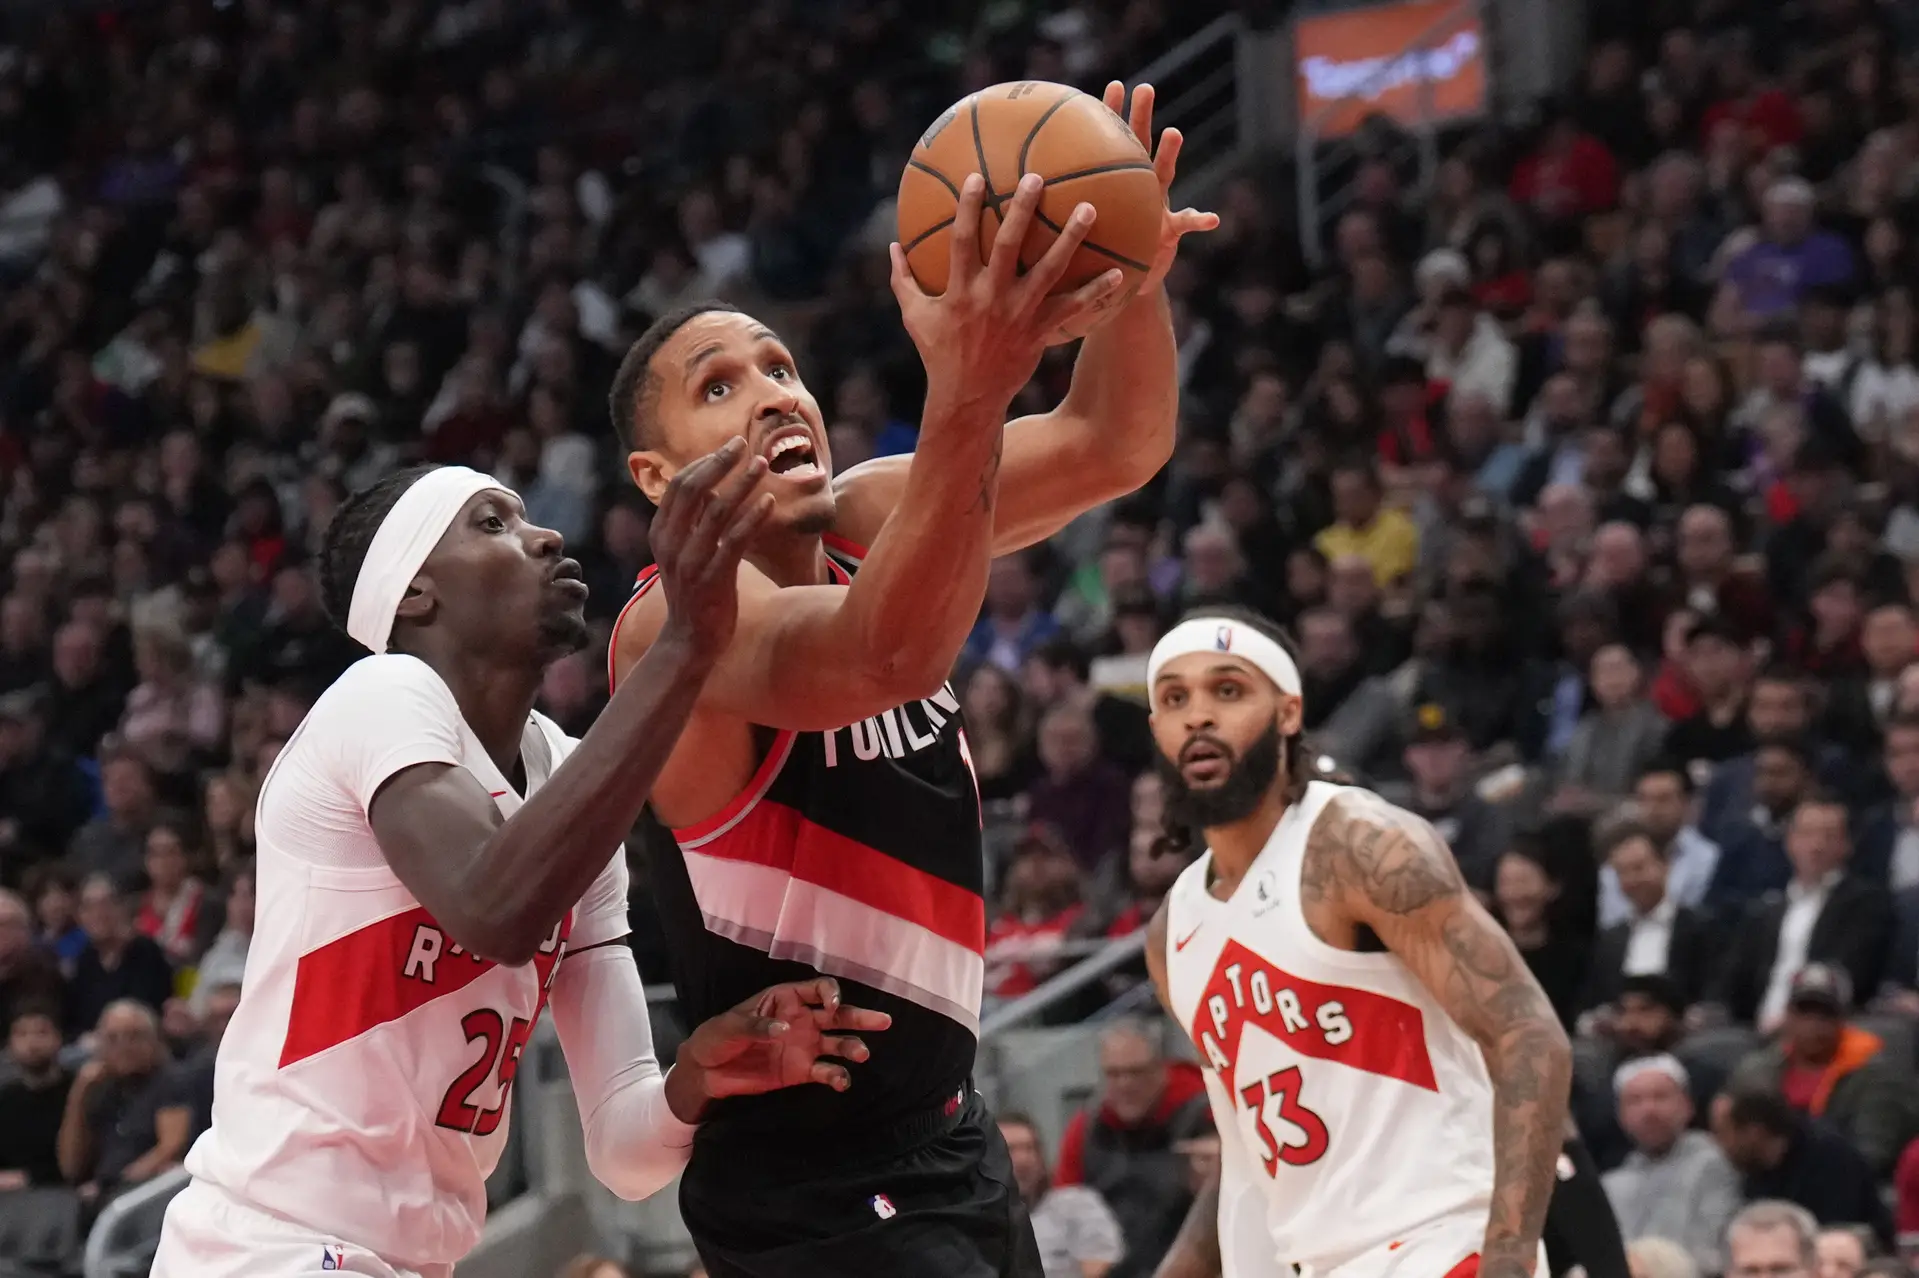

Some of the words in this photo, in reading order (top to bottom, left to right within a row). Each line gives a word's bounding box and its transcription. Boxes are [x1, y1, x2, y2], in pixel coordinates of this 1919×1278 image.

[435, 1007, 529, 1136] 25
[1201, 962, 1353, 1075] APTORS
[1240, 1065, 1330, 1180] 33
